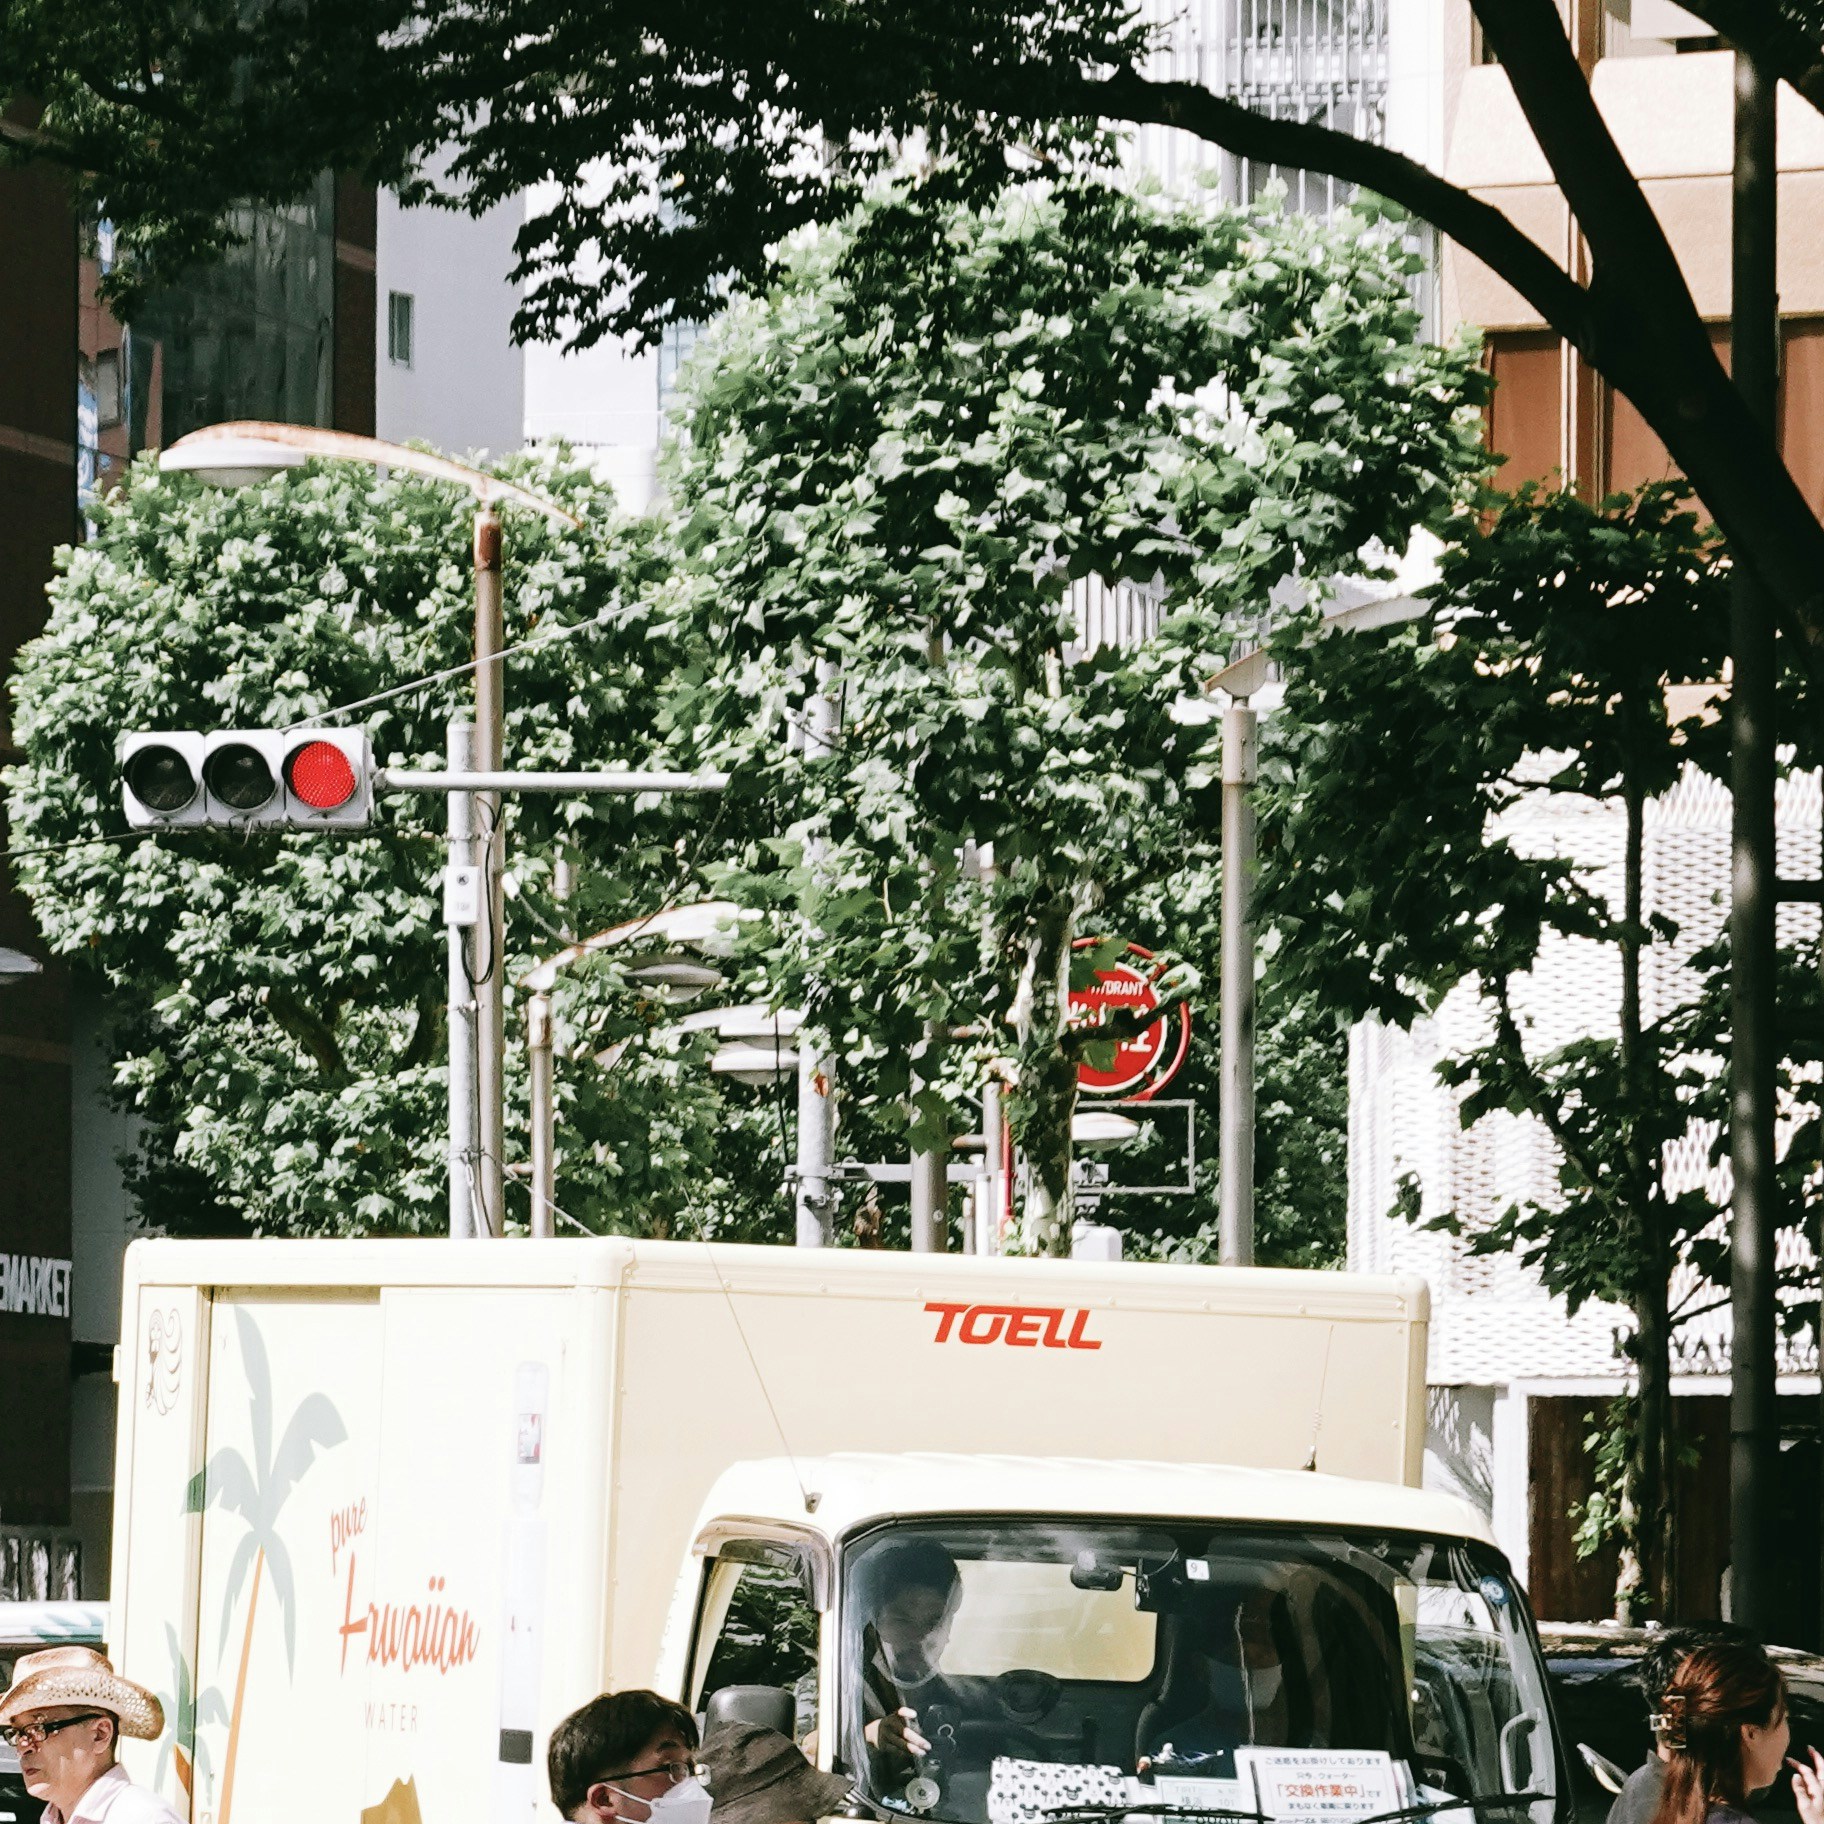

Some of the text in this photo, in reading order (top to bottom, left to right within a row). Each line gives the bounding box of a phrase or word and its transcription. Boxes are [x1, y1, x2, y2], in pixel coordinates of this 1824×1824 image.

[923, 1301, 1103, 1351] TOELL
[330, 1495, 369, 1578] pure
[364, 1701, 419, 1732] WATER
